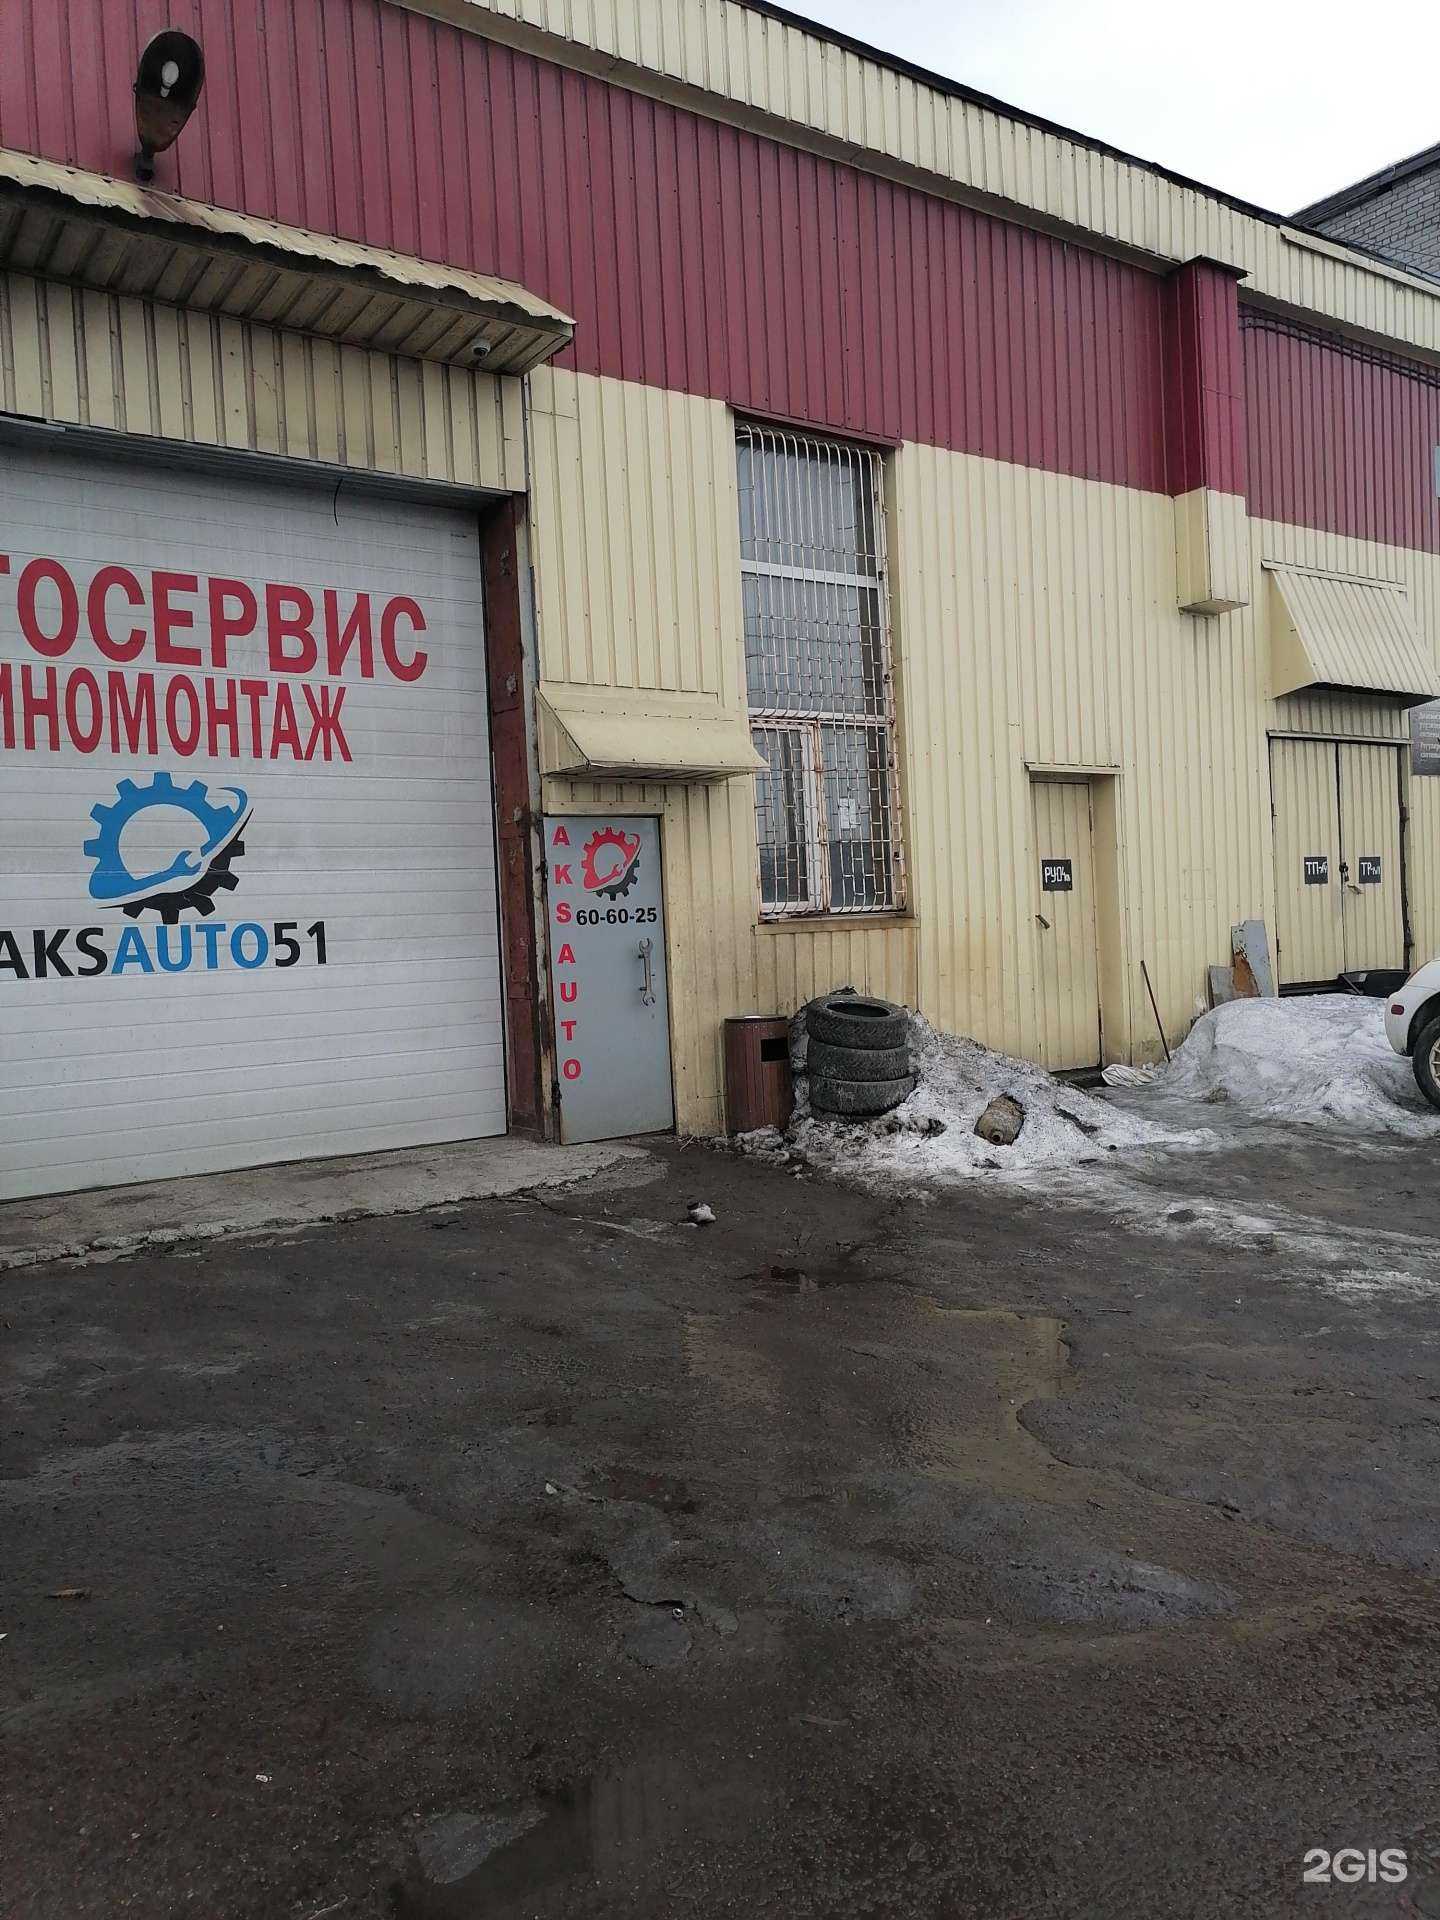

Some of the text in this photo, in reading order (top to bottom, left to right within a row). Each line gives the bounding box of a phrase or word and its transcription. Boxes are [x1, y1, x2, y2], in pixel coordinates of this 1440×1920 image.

[0, 555, 428, 682] ОСЕРВИС
[576, 907, 657, 926] 60-60-25
[0, 921, 327, 979] AKSAUTO51
